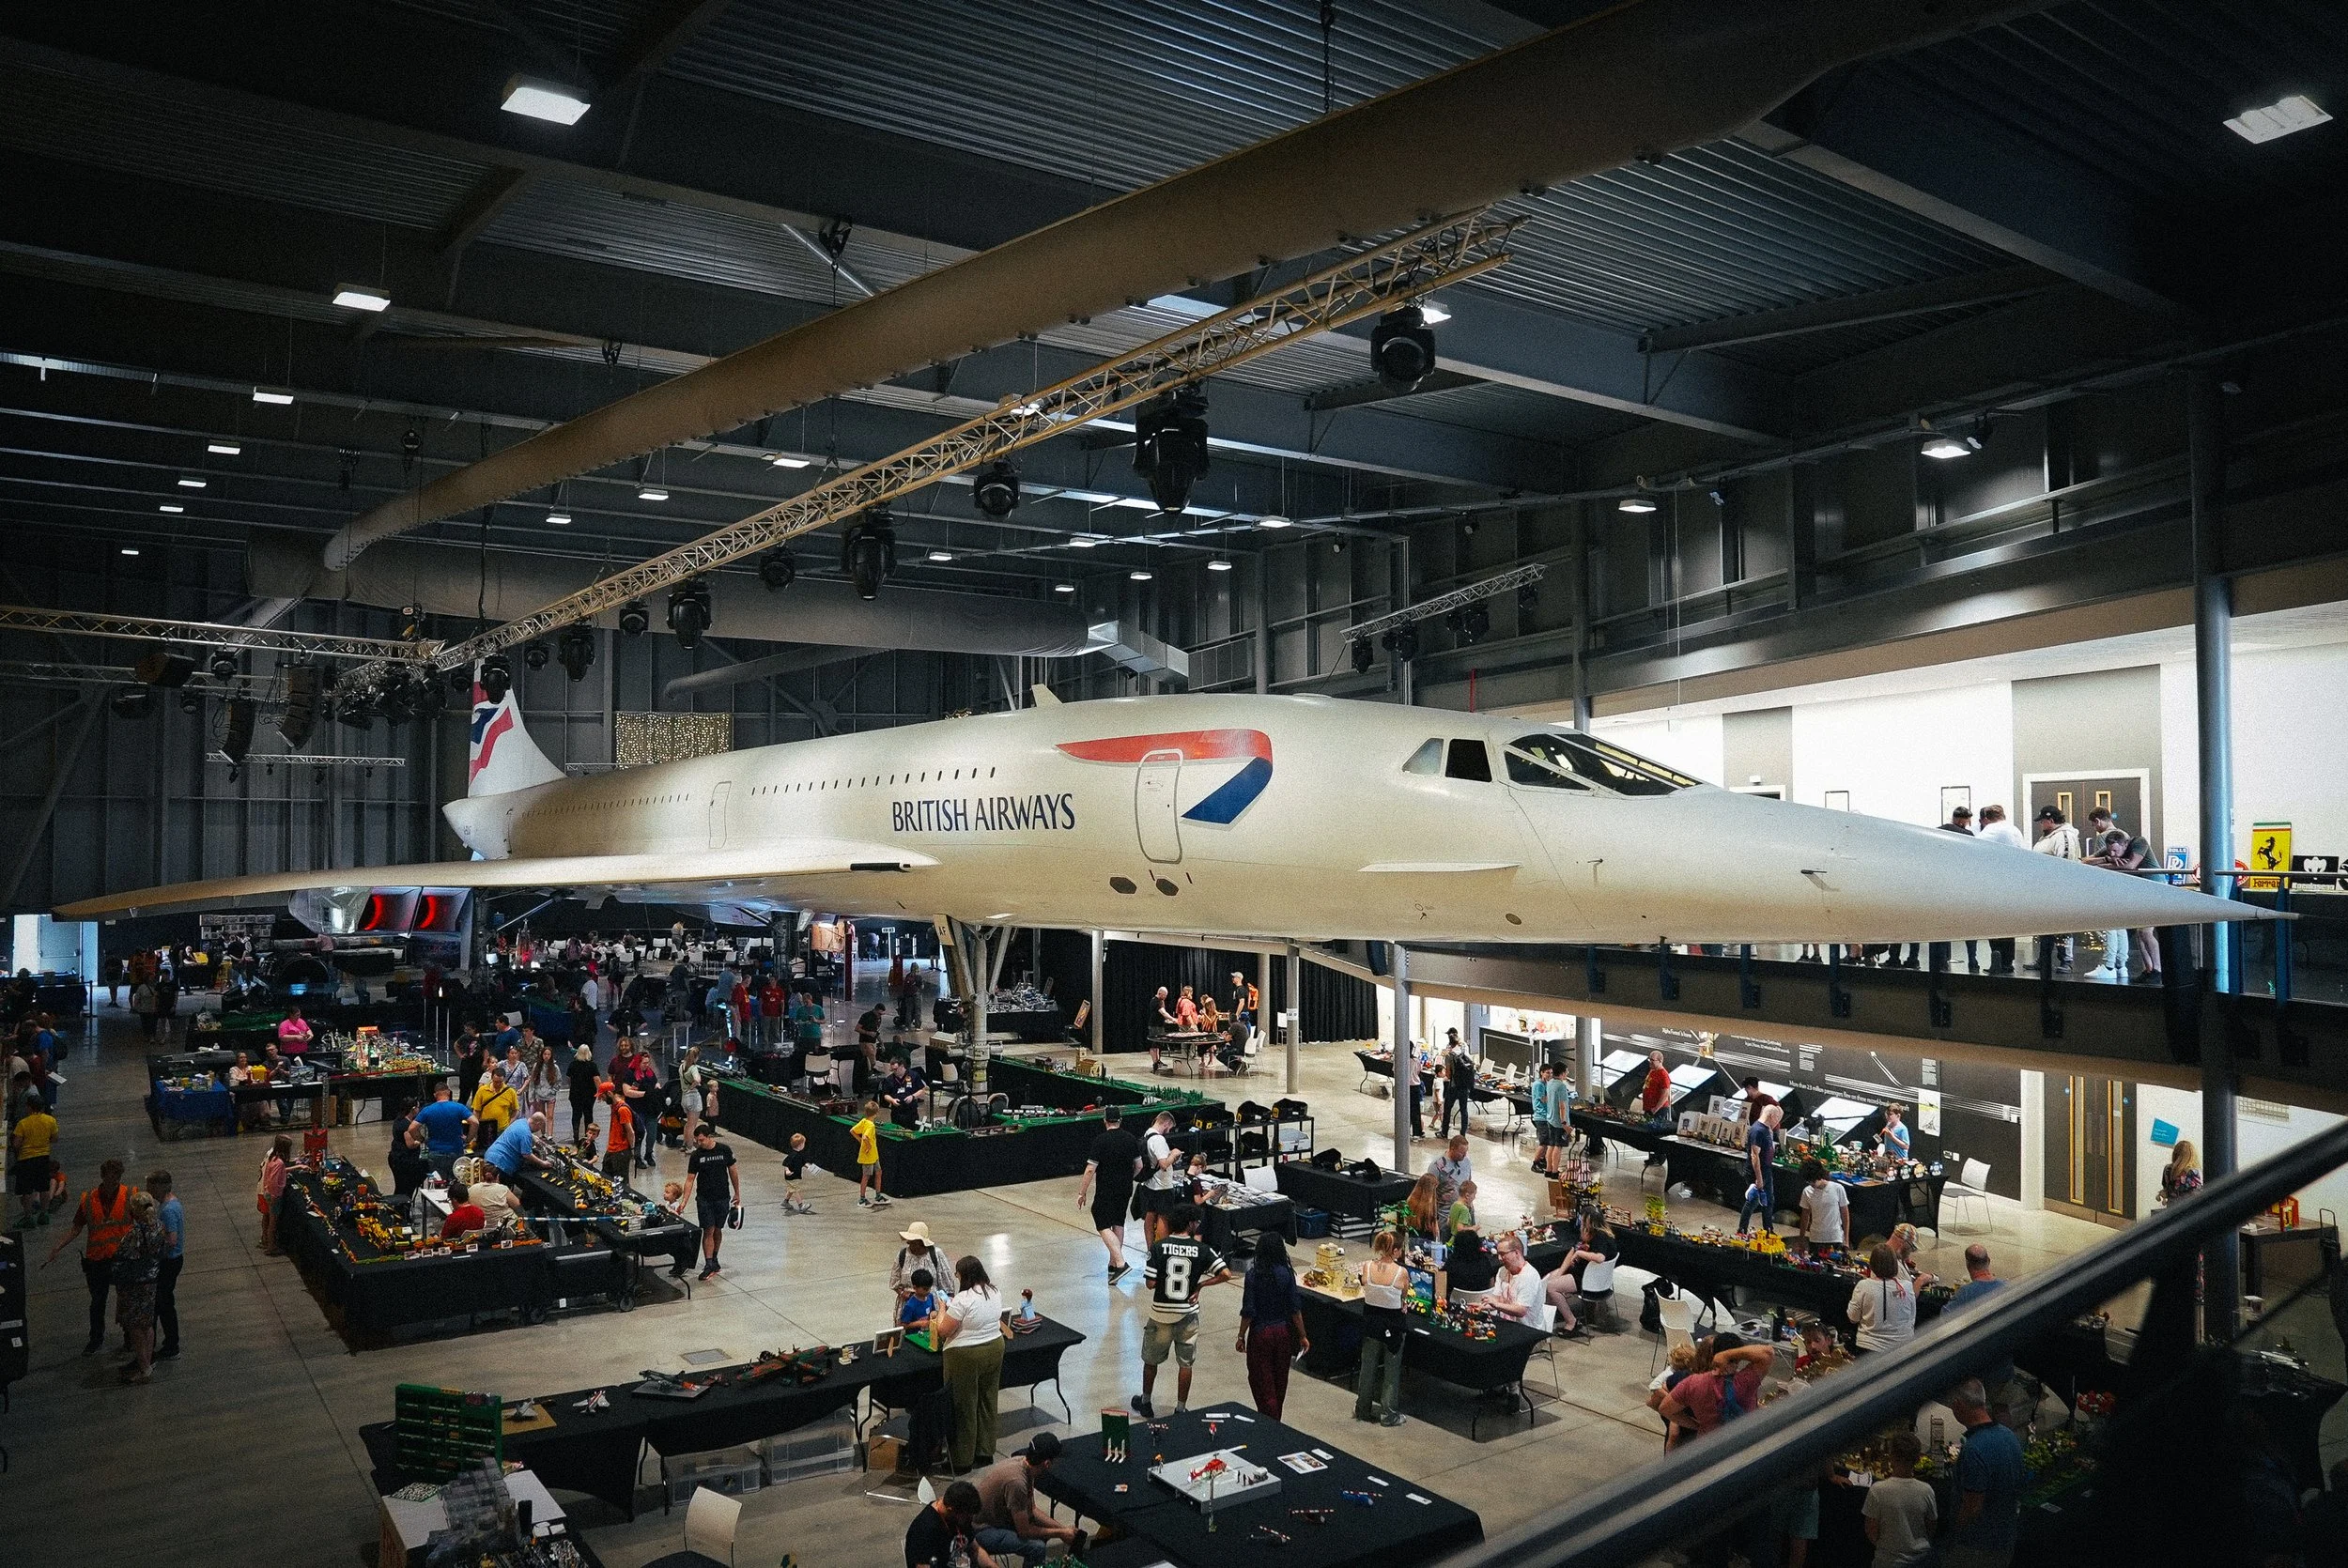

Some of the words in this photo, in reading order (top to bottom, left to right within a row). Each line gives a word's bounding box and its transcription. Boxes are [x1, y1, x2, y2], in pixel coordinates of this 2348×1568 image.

[892, 799, 969, 832] BRITISH
[975, 792, 1076, 831] AIRWAYS
[2253, 878, 2280, 888] Ferrar
[1162, 1243, 1198, 1257] TIGERS
[1166, 1256, 1192, 1300] 8
